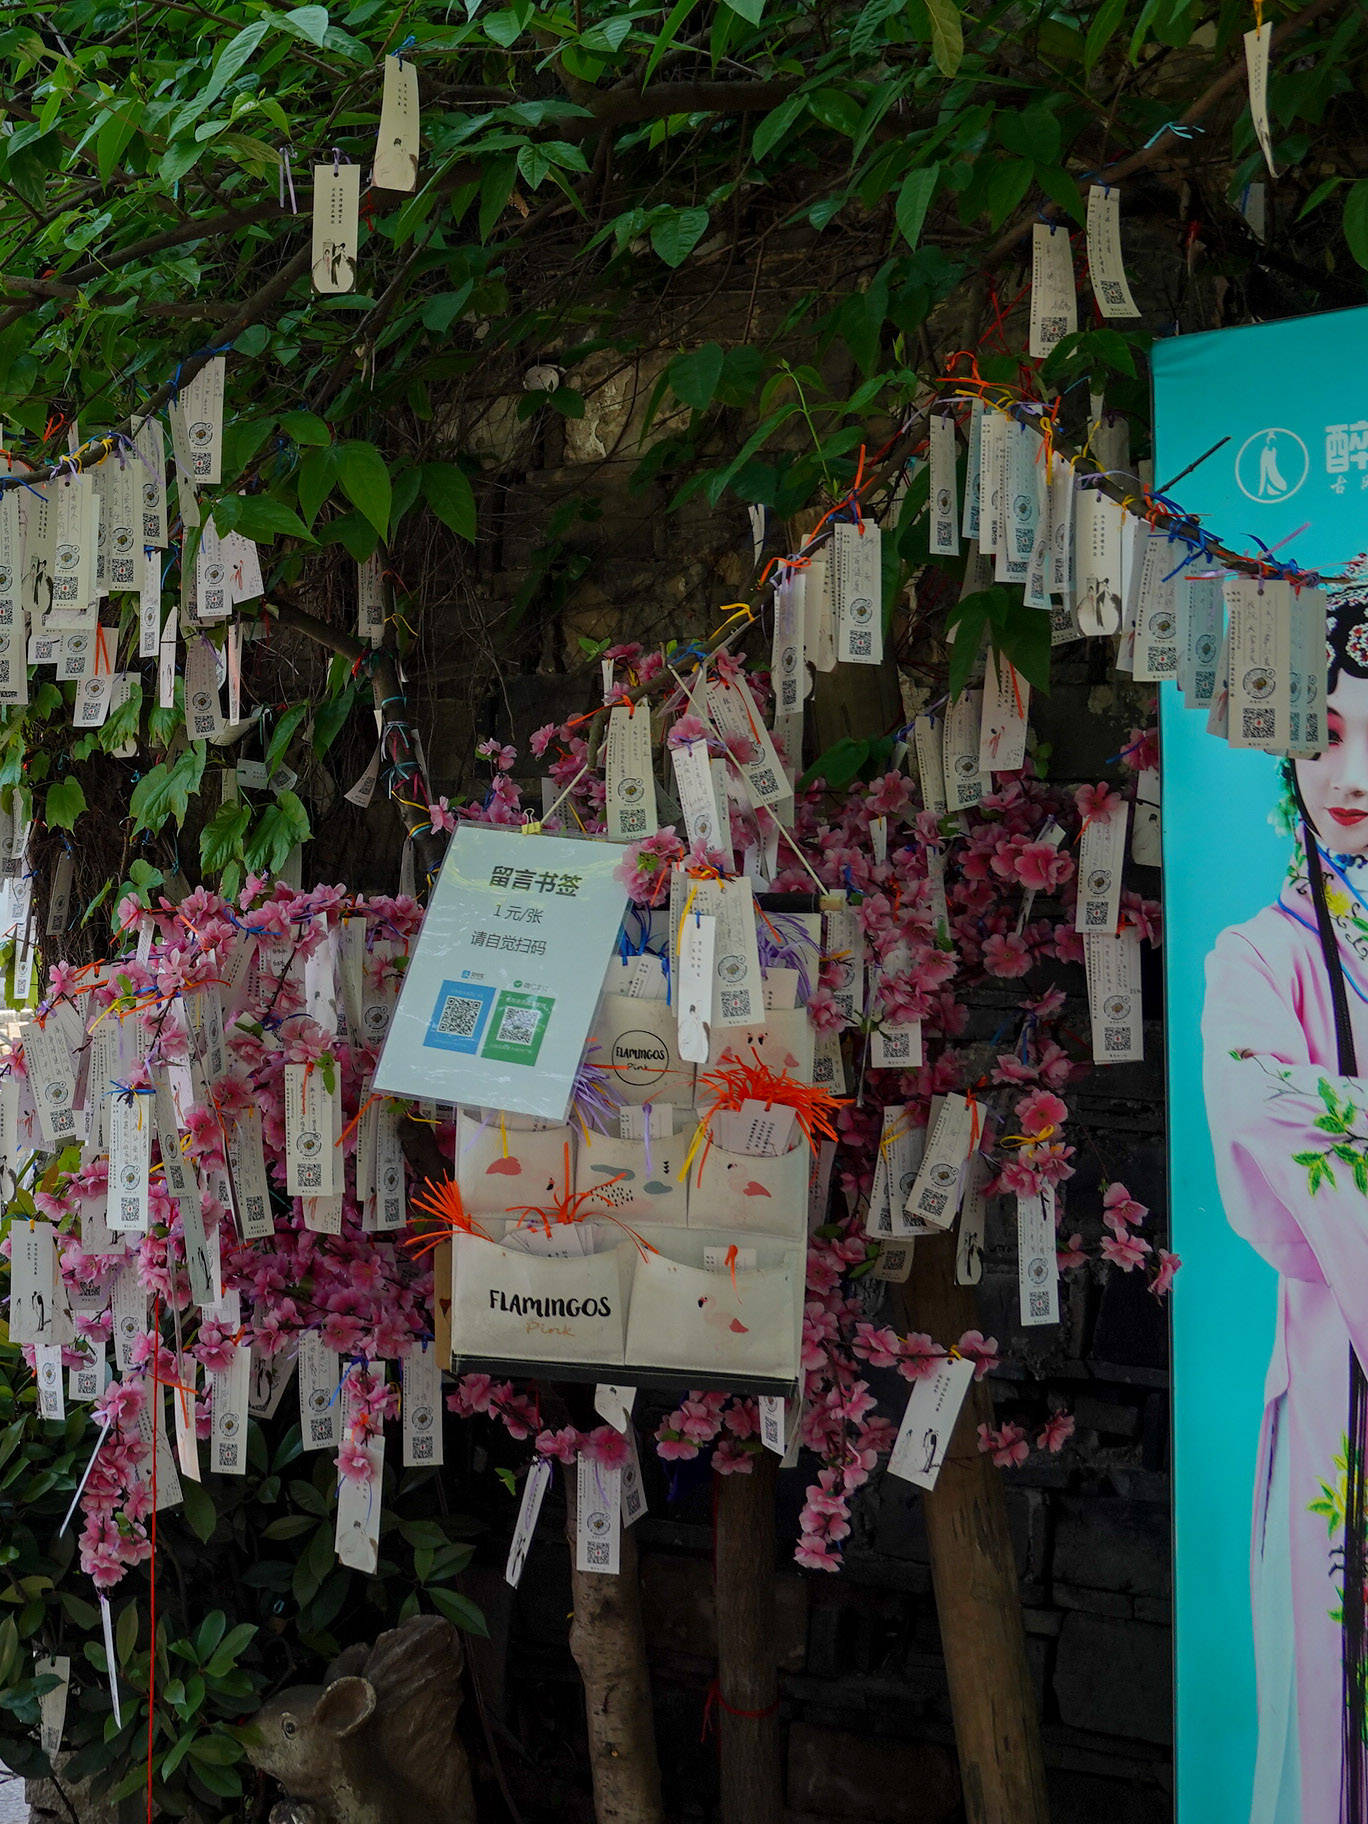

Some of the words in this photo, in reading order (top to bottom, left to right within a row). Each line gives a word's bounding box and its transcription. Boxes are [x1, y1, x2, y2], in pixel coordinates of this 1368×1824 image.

[489, 865, 583, 897] 留言书签
[470, 930, 547, 956] 请自觉扫码
